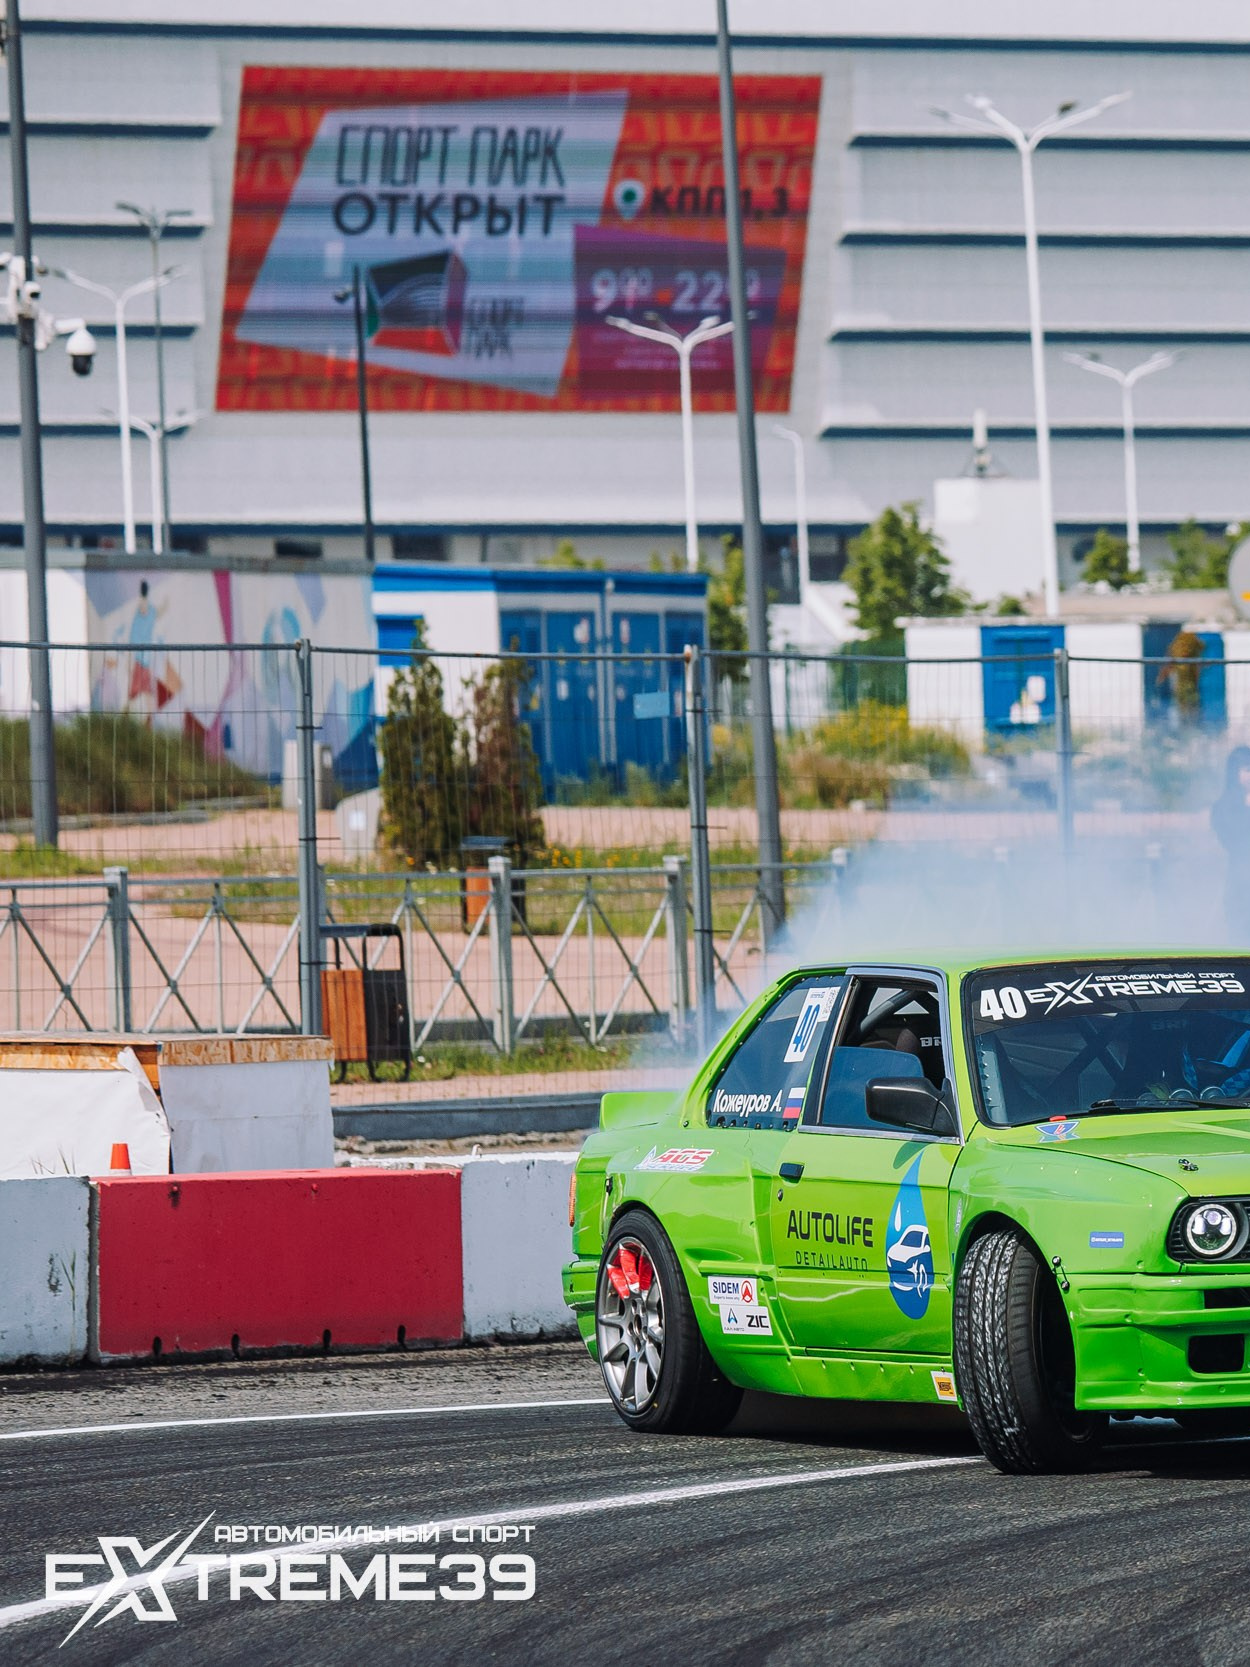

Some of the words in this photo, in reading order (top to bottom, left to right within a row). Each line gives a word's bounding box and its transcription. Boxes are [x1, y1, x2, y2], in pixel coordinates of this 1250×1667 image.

[335, 124, 458, 187] СПОРТ
[468, 124, 566, 187] ПАРК
[332, 192, 565, 236] ОТКРЫТ
[1024, 972, 1246, 1016] EXTREME39
[1095, 971, 1196, 982] АВТОМОБИЛЬНЫЙ
[1199, 972, 1236, 980] СПОРТ
[980, 986, 1027, 1021] 40
[793, 1004, 821, 1053] 40
[713, 1089, 772, 1118] Кожеуров
[769, 1089, 783, 1112] А.
[787, 1210, 873, 1247] AUTOLIFE
[796, 1251, 868, 1271] DETAILAUTO
[712, 1281, 740, 1295] SIDEM
[746, 1314, 769, 1328] ZIC
